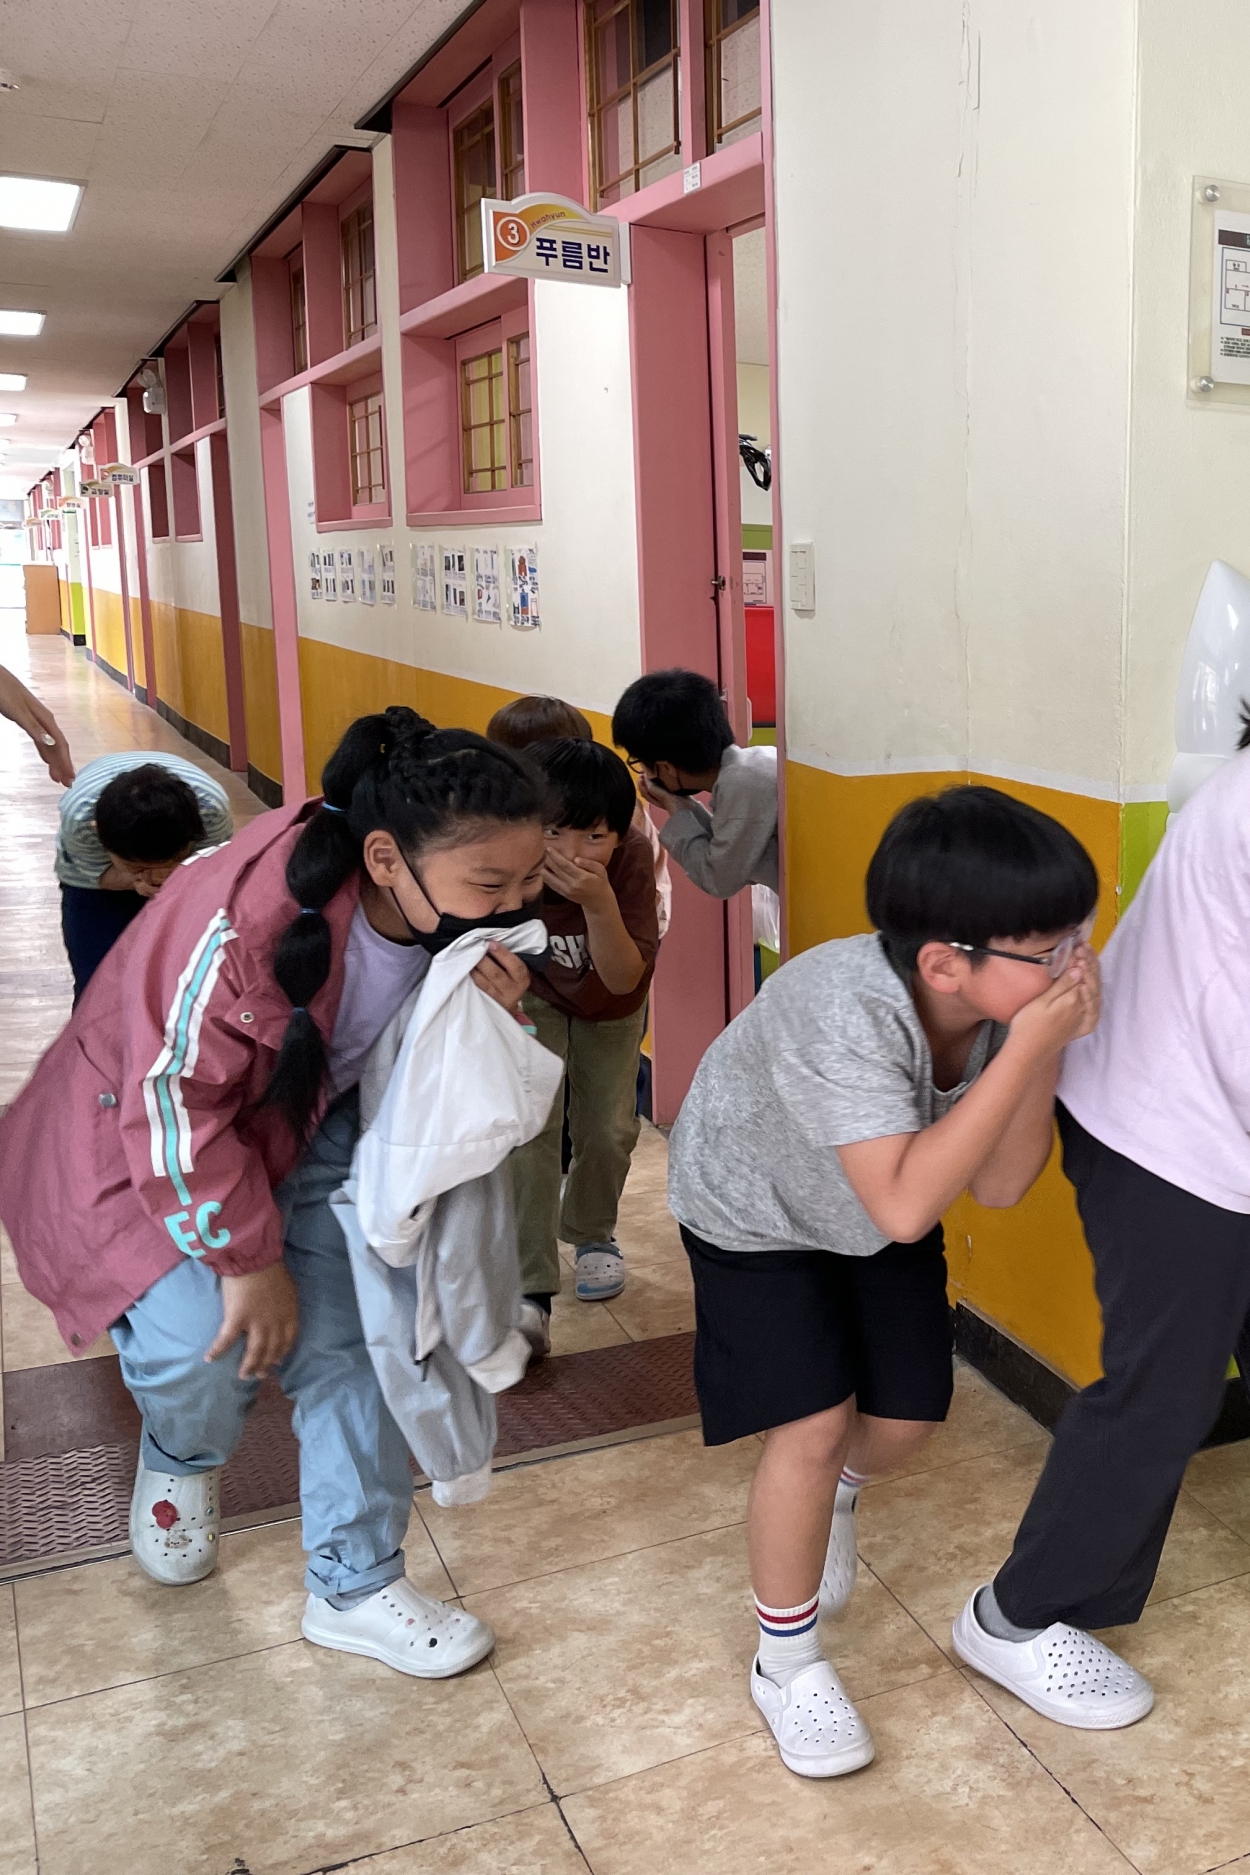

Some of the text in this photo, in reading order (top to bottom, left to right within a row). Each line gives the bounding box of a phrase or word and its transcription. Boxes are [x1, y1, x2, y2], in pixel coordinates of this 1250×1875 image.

[530, 211, 567, 229] Hwahyun
[507, 223, 520, 244] 3
[535, 237, 611, 273] 푸름반
